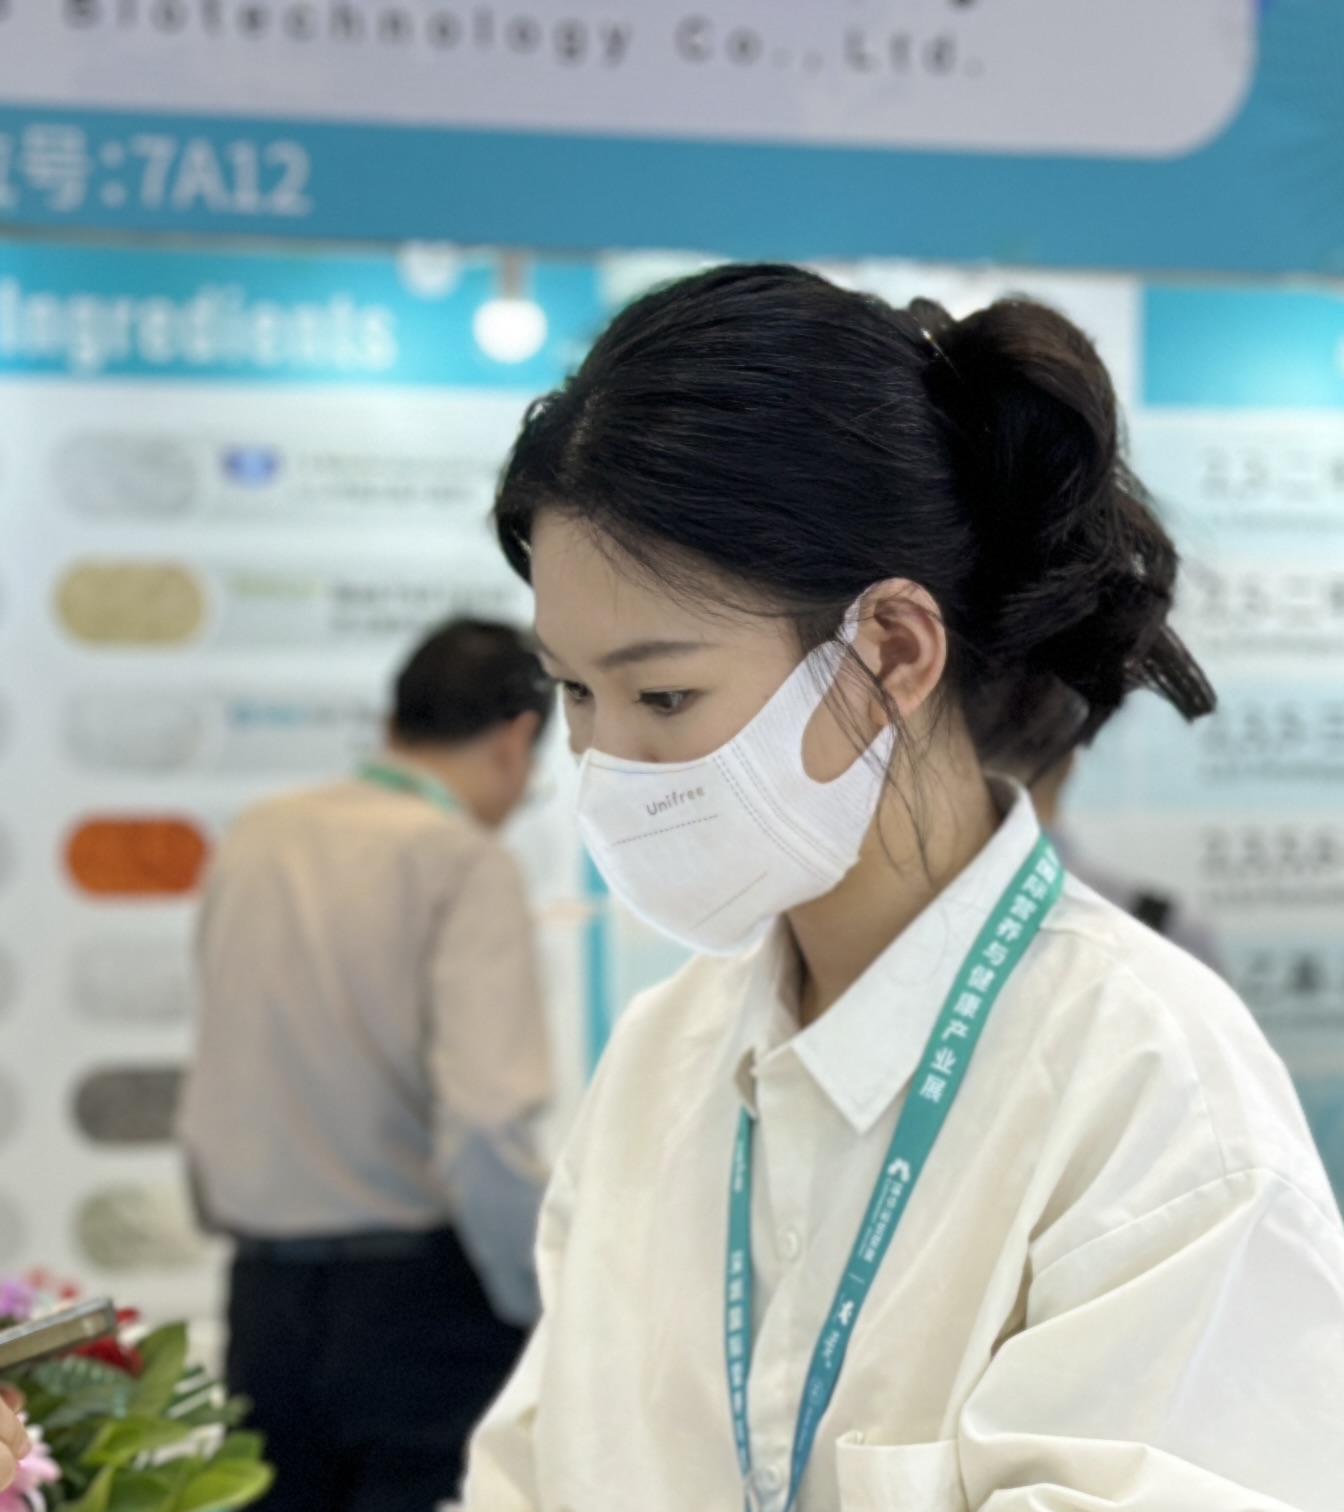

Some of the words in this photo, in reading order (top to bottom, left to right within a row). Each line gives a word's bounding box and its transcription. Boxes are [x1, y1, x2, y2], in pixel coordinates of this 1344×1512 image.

[646, 786, 706, 816] Unifree
[920, 846, 1059, 1103] 国际营养与健康产业展
